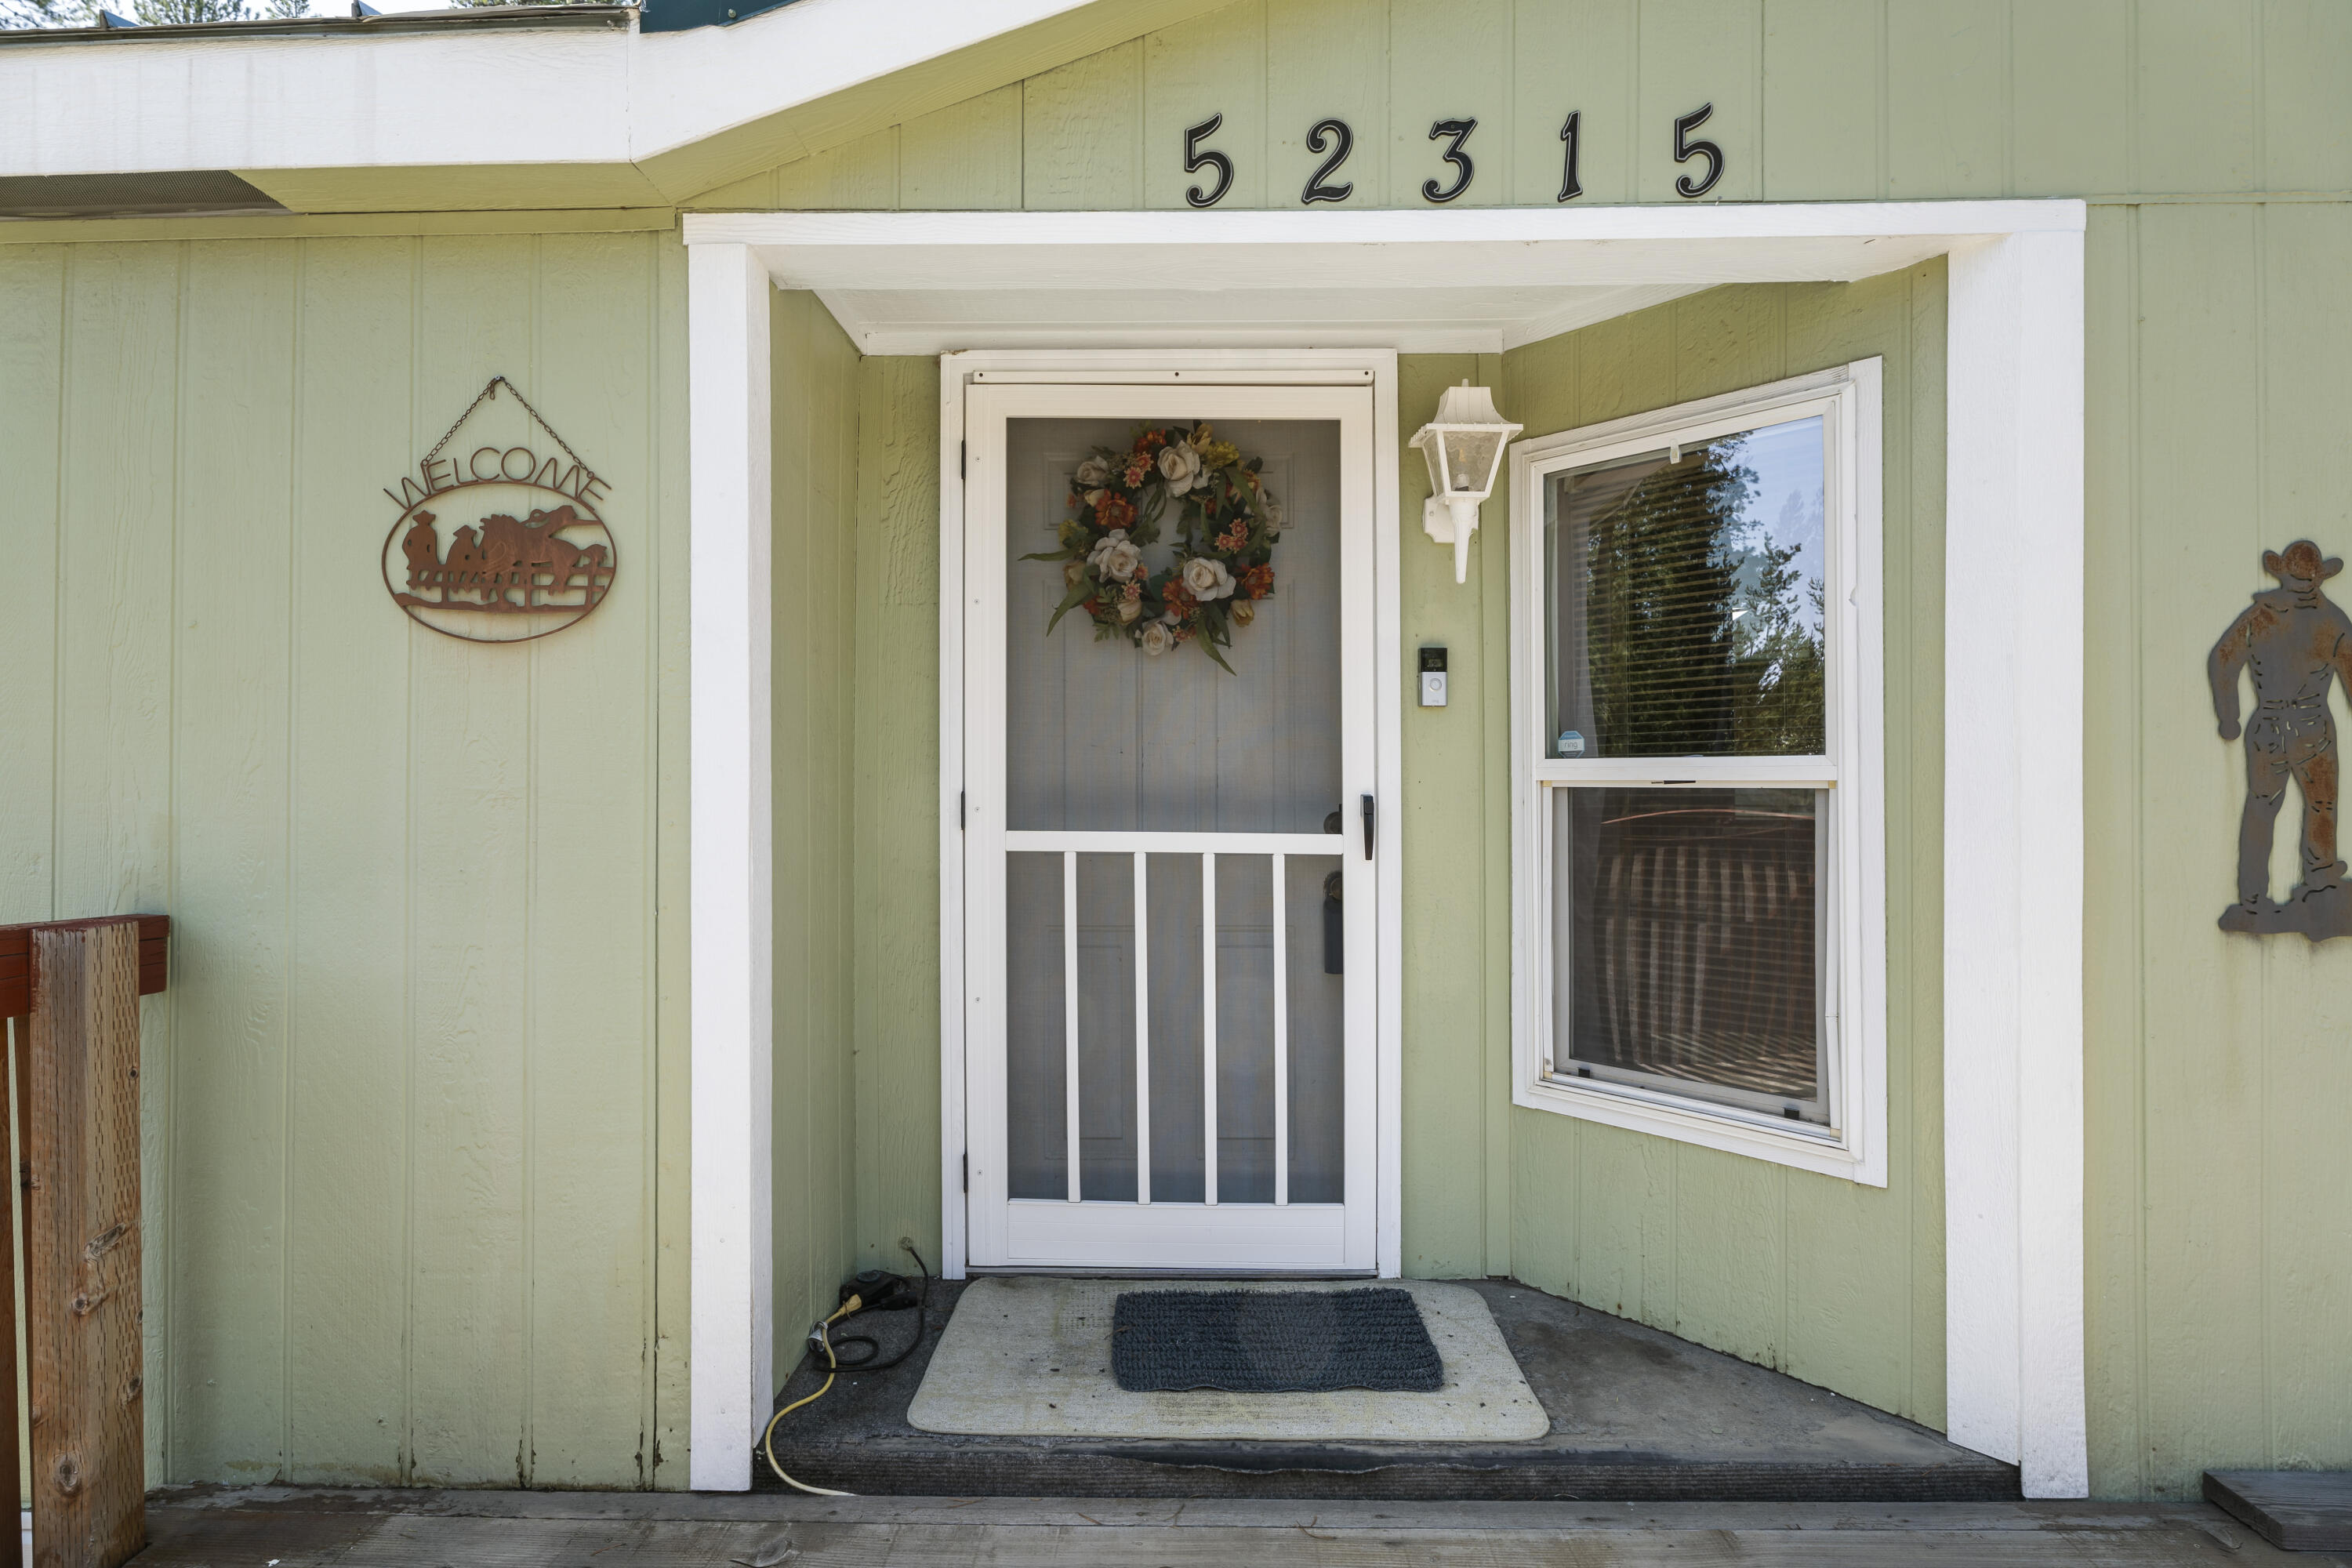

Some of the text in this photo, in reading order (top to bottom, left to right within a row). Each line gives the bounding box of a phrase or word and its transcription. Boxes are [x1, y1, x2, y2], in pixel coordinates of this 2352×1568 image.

[1184, 102, 1725, 208] 52315
[383, 447, 612, 512] WELCOME
[1564, 741, 1578, 750] ring
